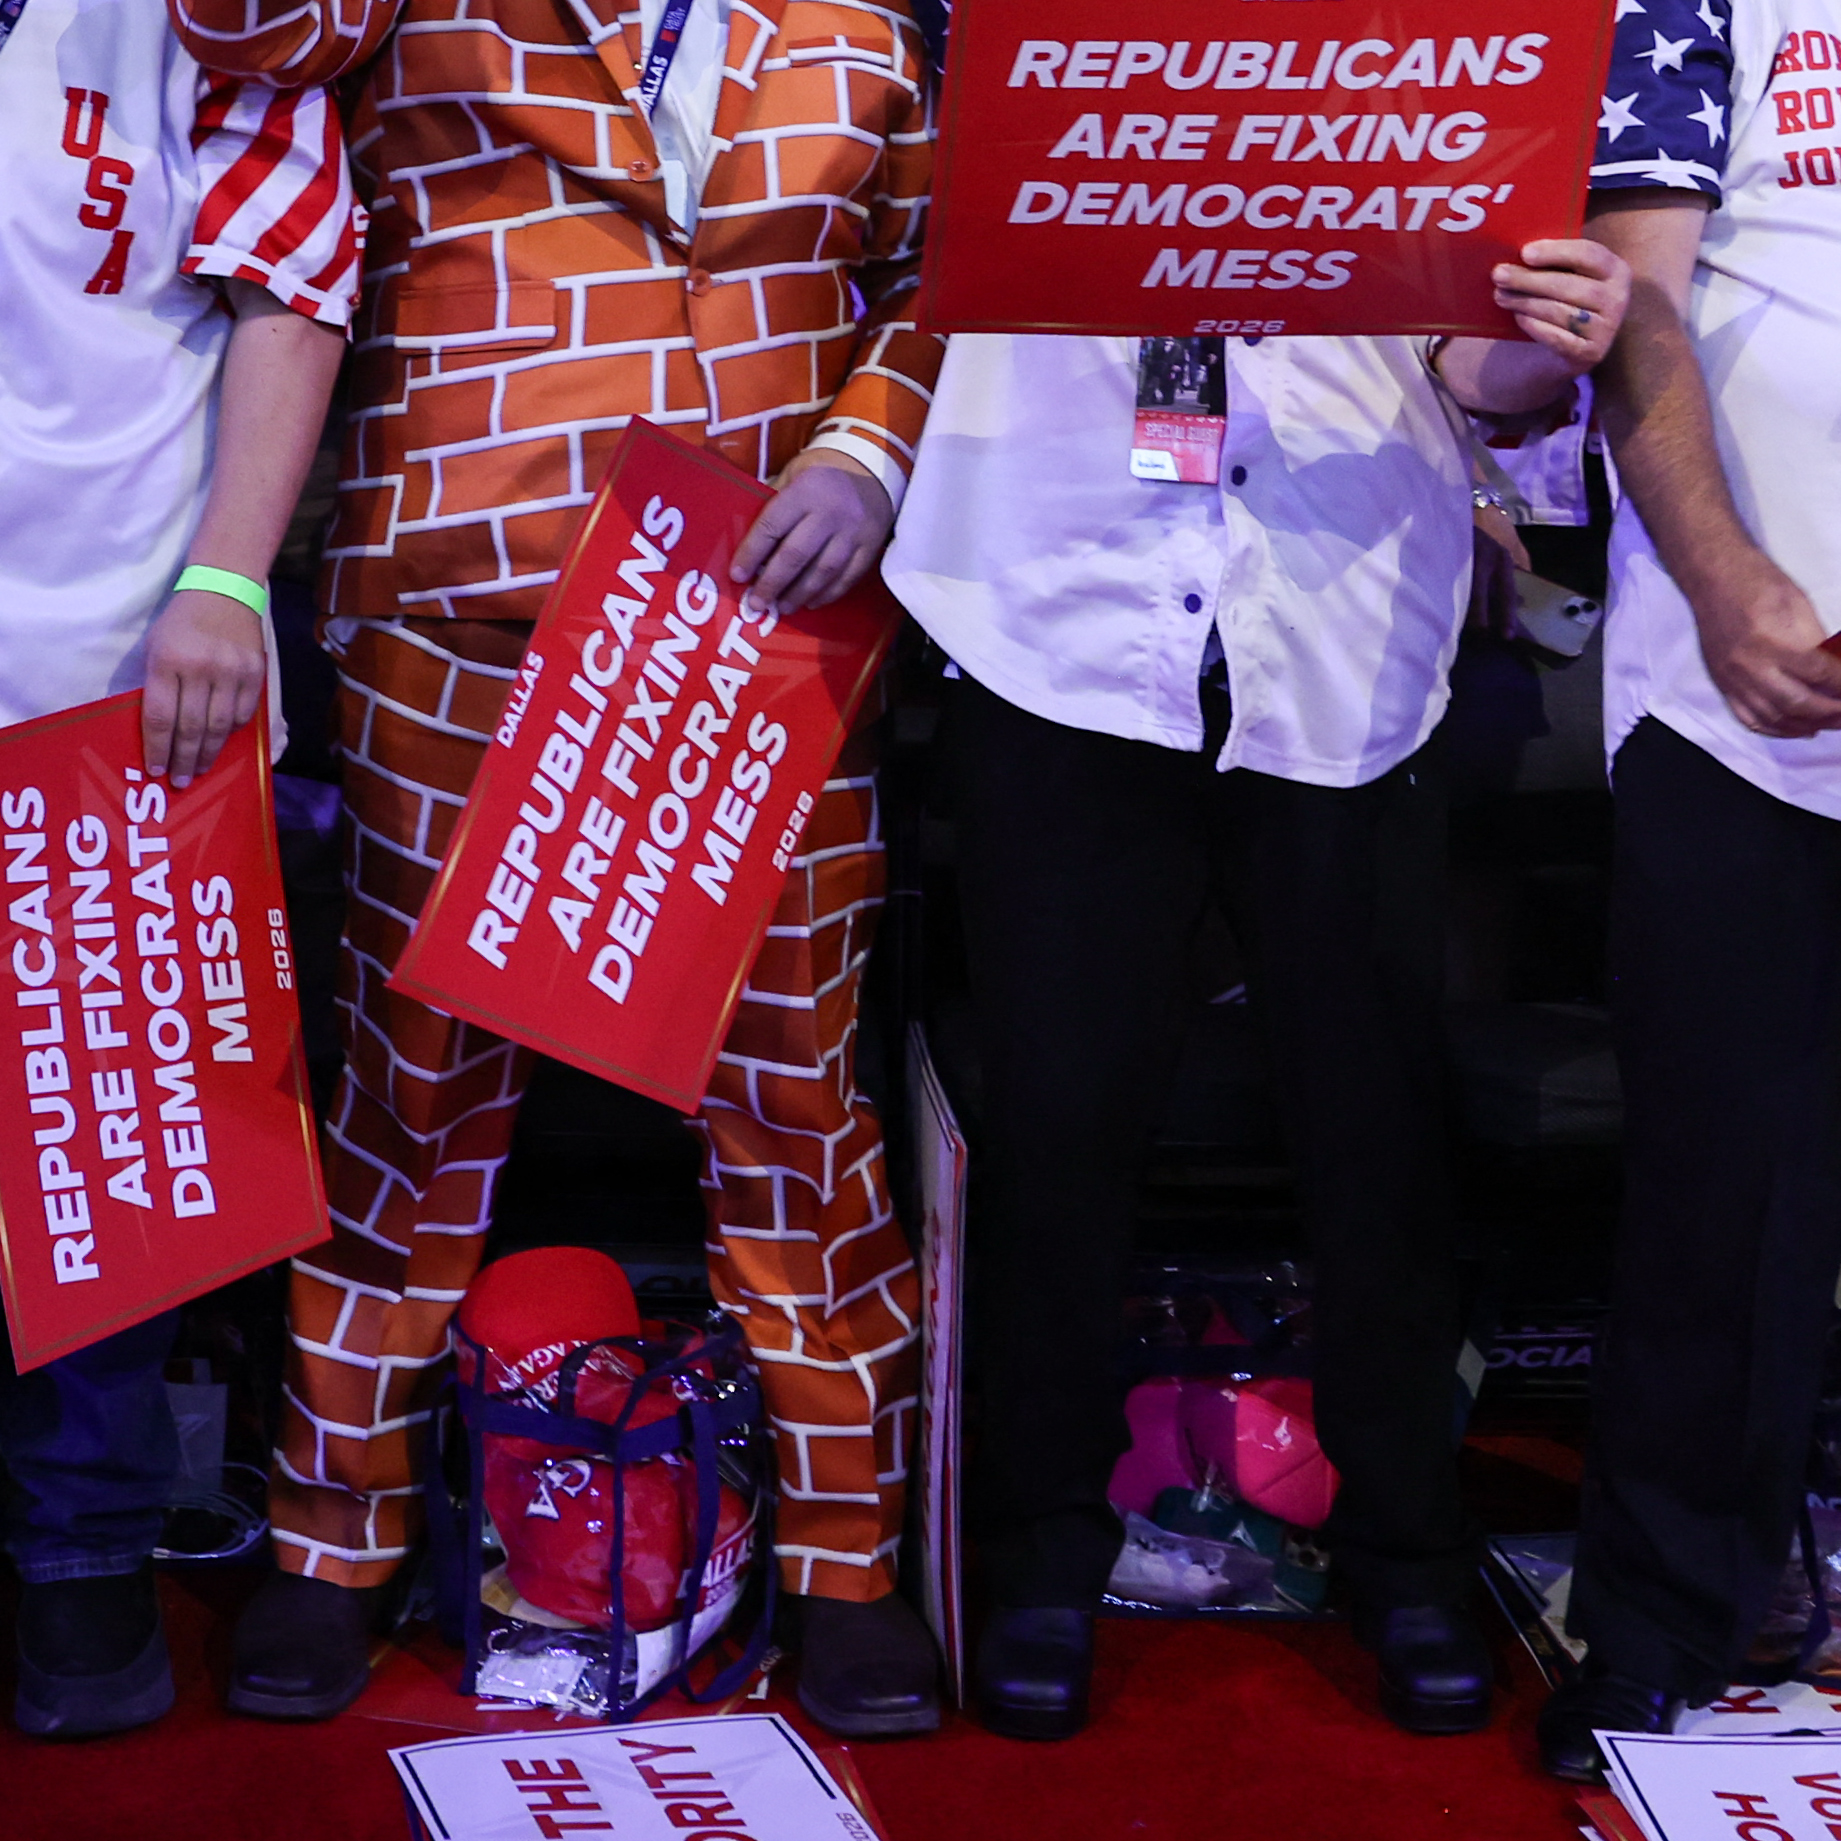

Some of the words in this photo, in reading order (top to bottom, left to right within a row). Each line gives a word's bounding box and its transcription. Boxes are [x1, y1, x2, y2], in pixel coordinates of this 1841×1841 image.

[1007, 33, 1549, 91] REPUBLICANS
[62, 87, 135, 296] USA
[1007, 181, 1513, 232] DEMOCRATS'
[1048, 113, 1220, 160] ARE
[1228, 111, 1487, 162] FIXING
[1140, 249, 1358, 289] MESS
[1193, 319, 1285, 334] 2026
[466, 496, 685, 971] REPUBLICANS
[496, 652, 546, 748] DALLAS
[546, 798, 627, 954] ARE
[601, 569, 718, 799] FIXING
[689, 712, 789, 906] MESS
[772, 790, 814, 874] 2026
[66, 813, 129, 1049] FIXING
[124, 768, 216, 1218] DEMOCRATS'
[191, 876, 252, 1062] MESS
[268, 909, 291, 989] 2026
[2, 787, 99, 1284] REPUBLICANS
[91, 1068, 152, 1210] ARE
